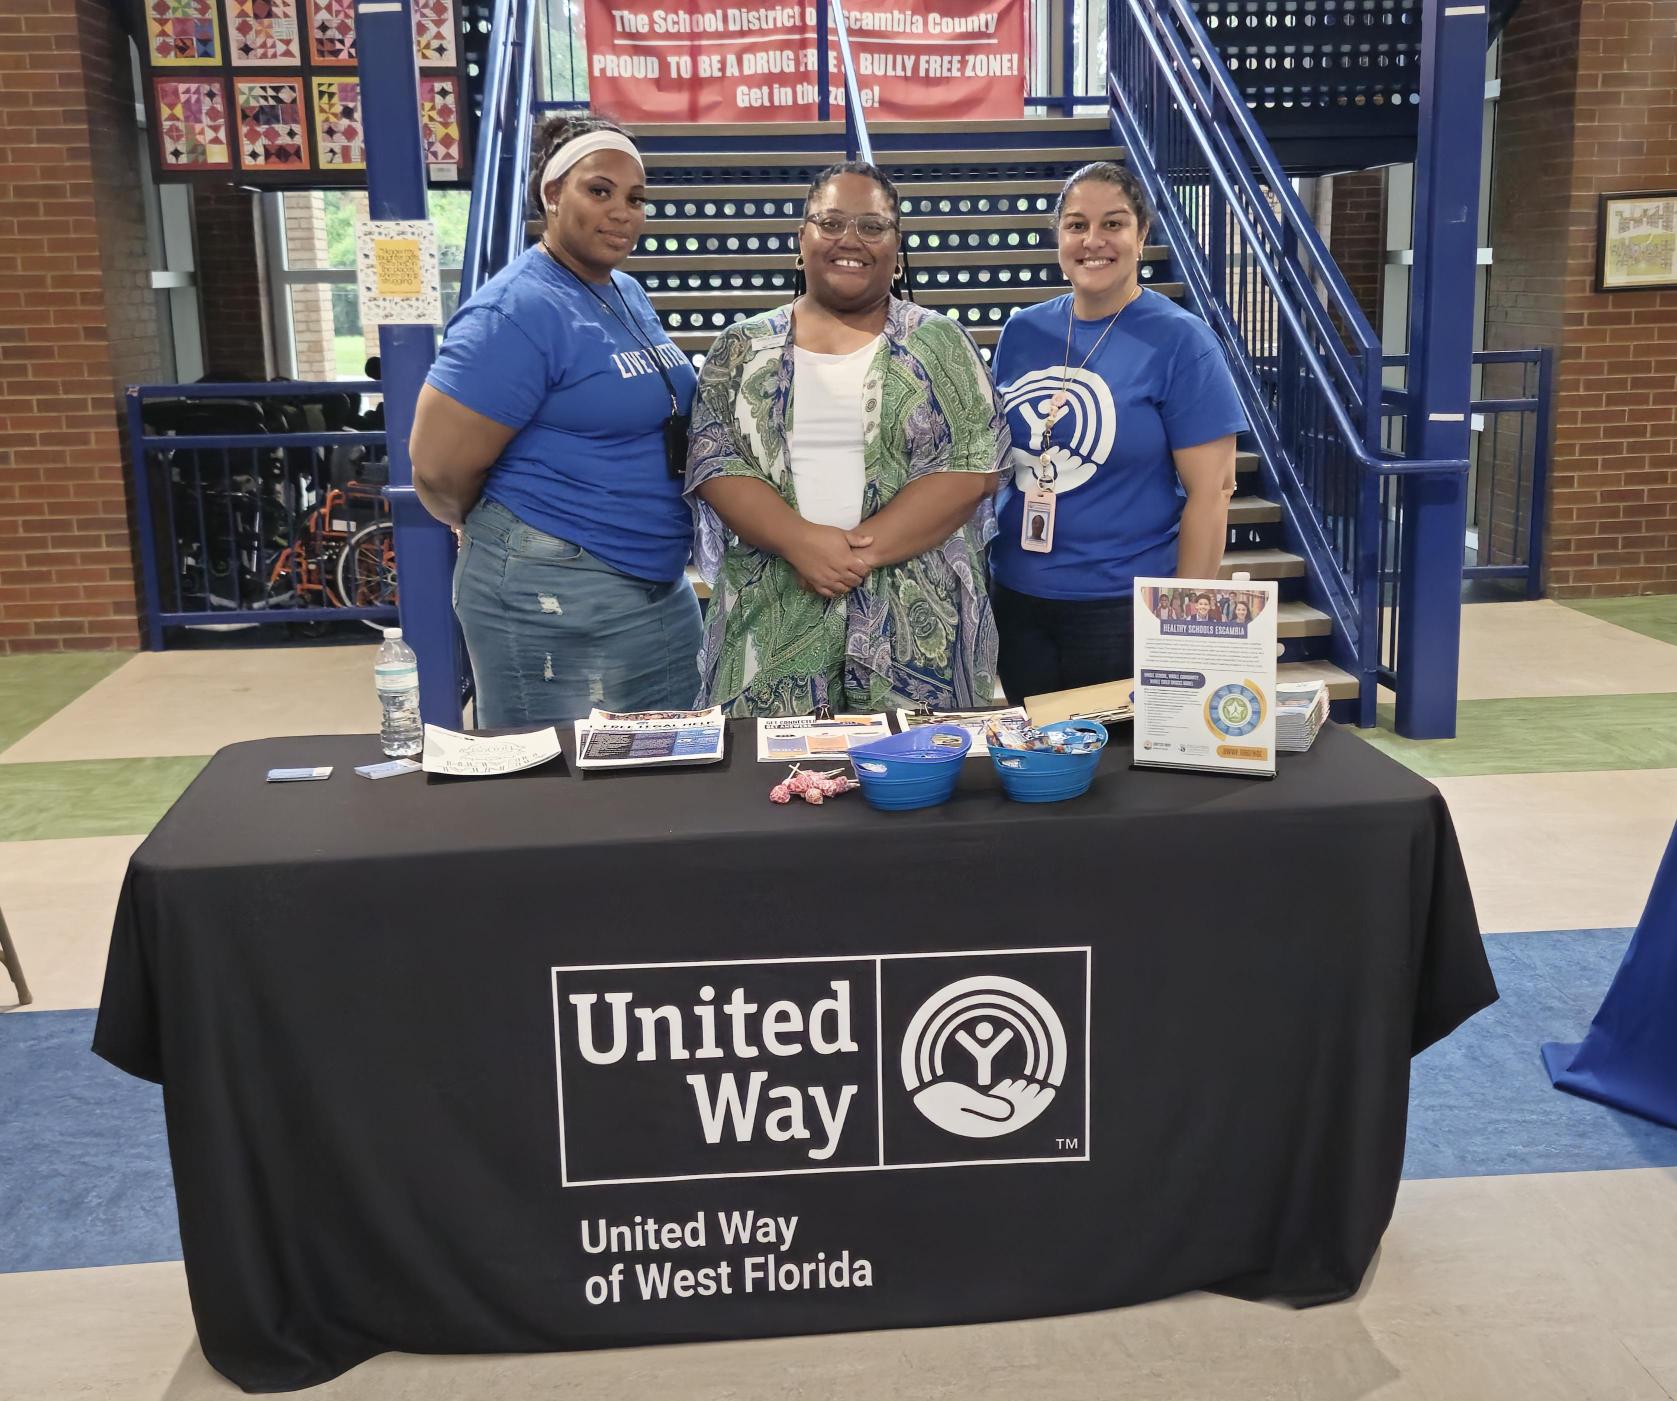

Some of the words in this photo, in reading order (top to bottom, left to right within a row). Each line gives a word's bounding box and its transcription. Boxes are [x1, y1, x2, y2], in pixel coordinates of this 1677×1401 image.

[612, 10, 649, 33] The
[653, 9, 724, 33] School
[727, 6, 802, 31] District
[928, 12, 998, 34] County
[592, 54, 659, 79] PROUD
[667, 56, 692, 79] TO
[698, 55, 722, 78] BE
[726, 54, 739, 77] A
[743, 50, 795, 75] DRUG
[799, 48, 838, 74] FRE
[860, 52, 915, 76] BULLY
[919, 54, 961, 78] FREE
[965, 53, 1018, 77] ZONE!
[736, 85, 771, 108] Get
[773, 84, 793, 107] in
[829, 85, 880, 108] zoe!
[610, 351, 653, 379] LIVE
[1163, 623, 1187, 633] HEALTHY
[1188, 624, 1214, 635] SCHOOLS
[569, 980, 859, 1065] United
[686, 1071, 858, 1160] Way
[1055, 1138, 1078, 1150] TM
[581, 1211, 706, 1254] United
[718, 1210, 798, 1251] Way
[585, 1263, 624, 1305] of
[635, 1261, 733, 1300] West
[744, 1250, 873, 1293] Florida
